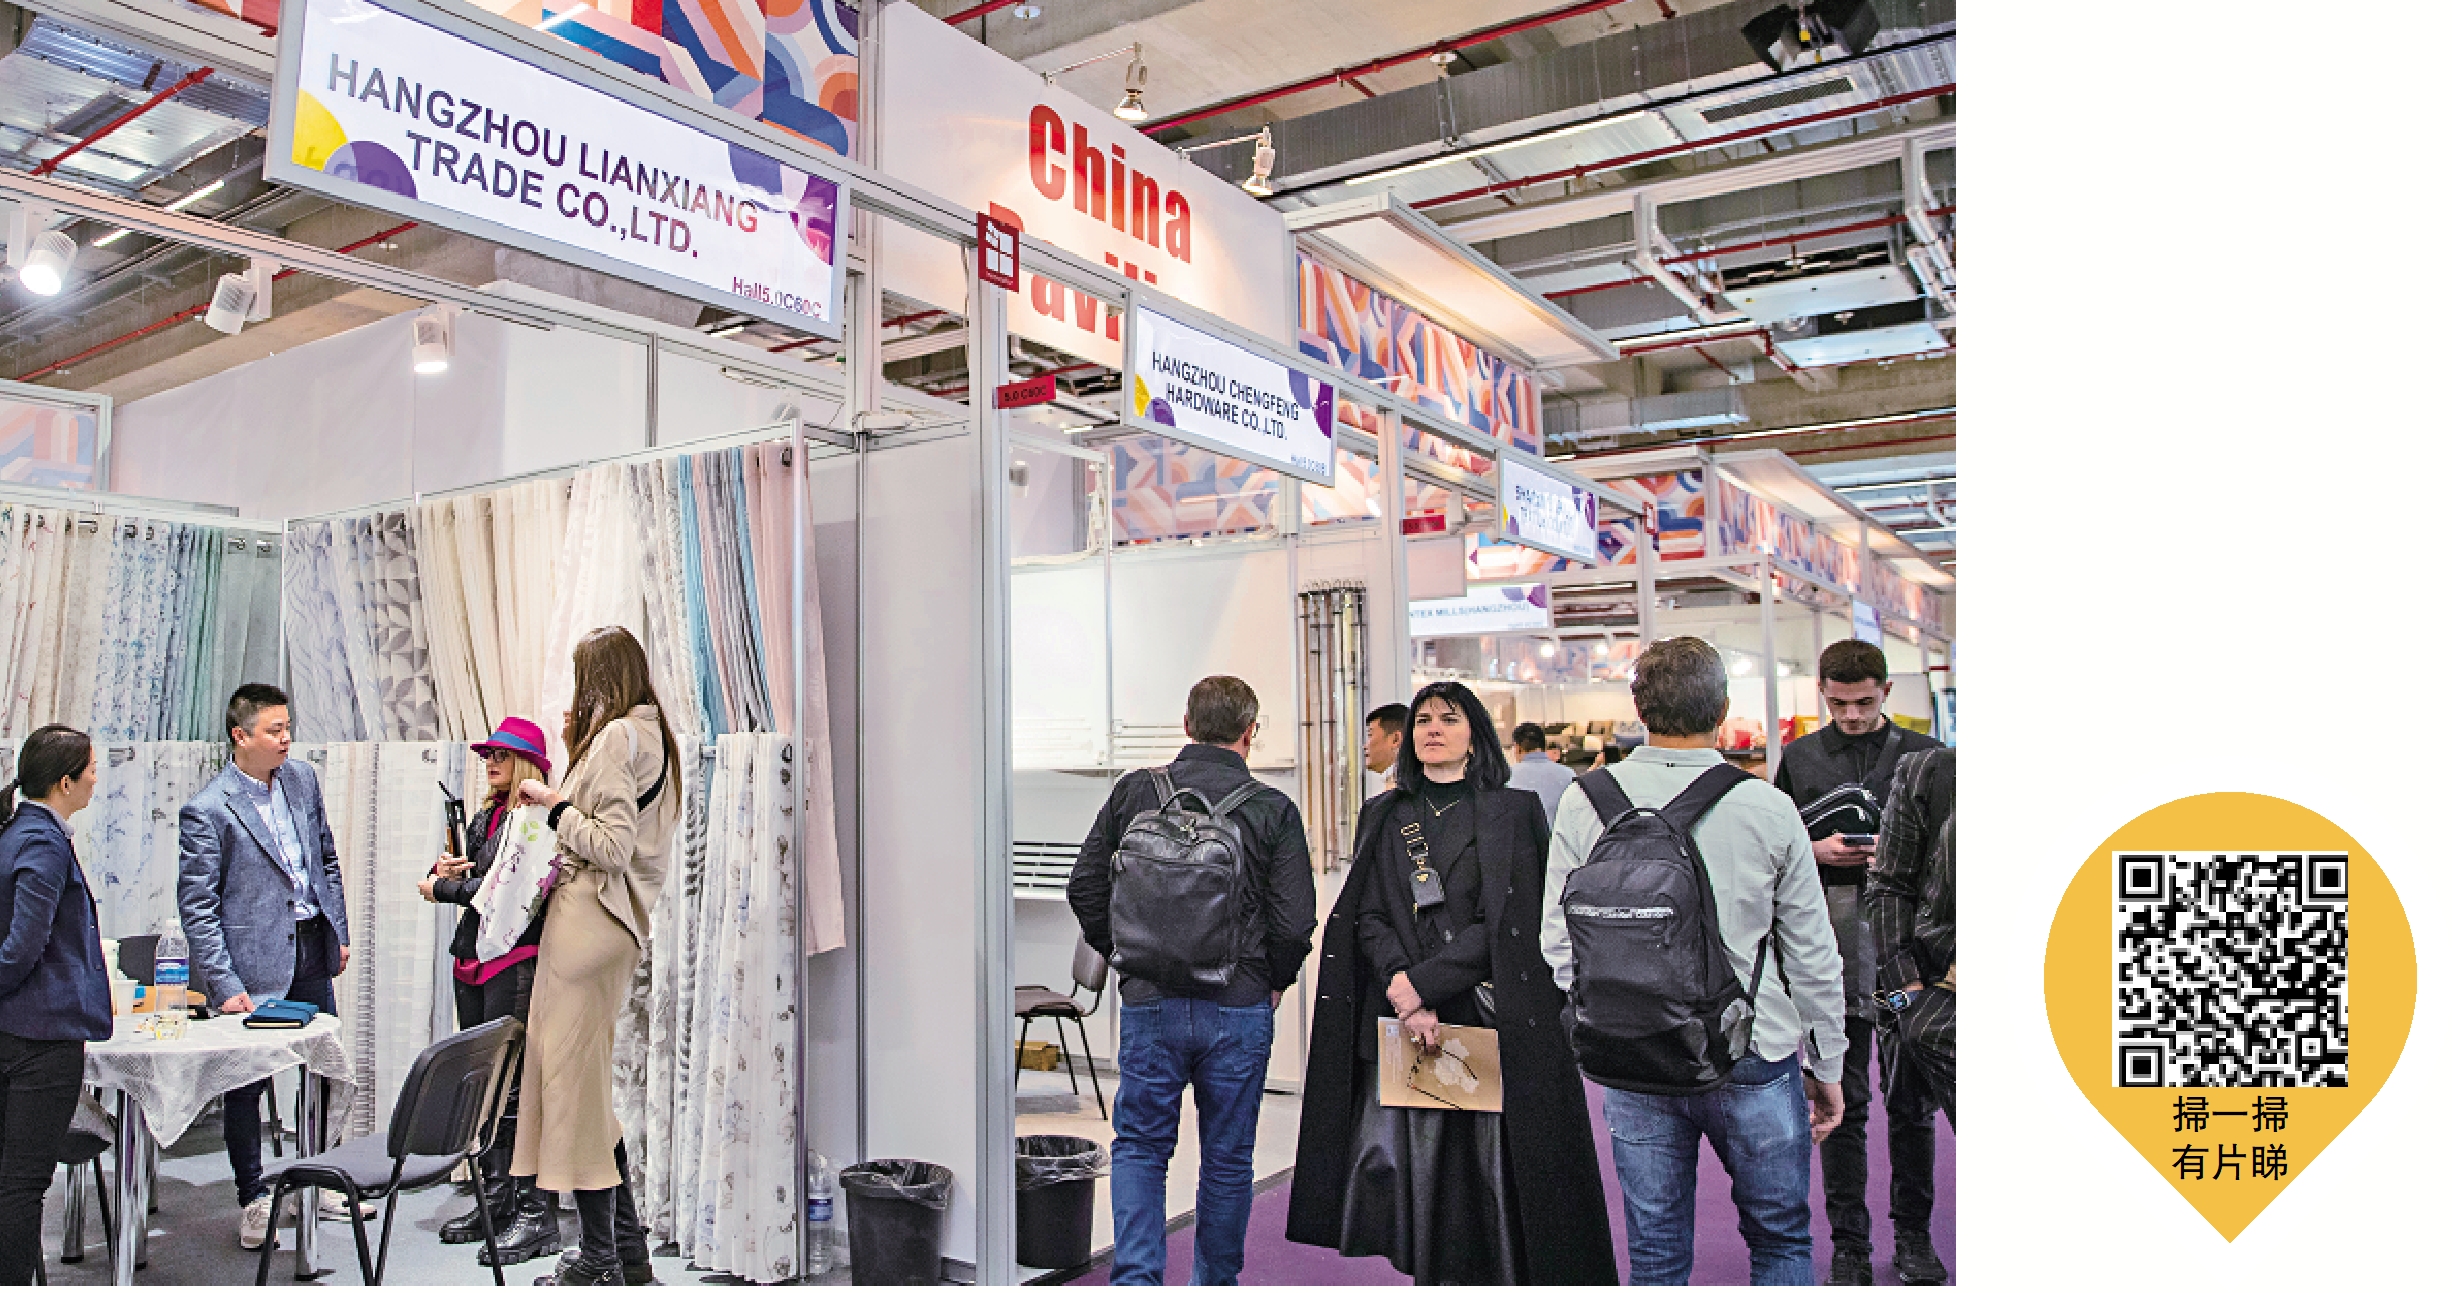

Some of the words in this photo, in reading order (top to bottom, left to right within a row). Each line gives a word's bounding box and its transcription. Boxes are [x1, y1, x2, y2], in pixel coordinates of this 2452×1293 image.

[329, 53, 566, 167] HANGZHOU
[580, 143, 759, 234] LIANXIANG
[406, 130, 544, 210] TRADE
[557, 183, 700, 258] CO.,LTD.
[1029, 103, 1191, 264] China
[1152, 350, 1226, 395] HANGZHOU
[1229, 379, 1299, 421] CHENGFENG
[1166, 382, 1239, 425] HARDWARE
